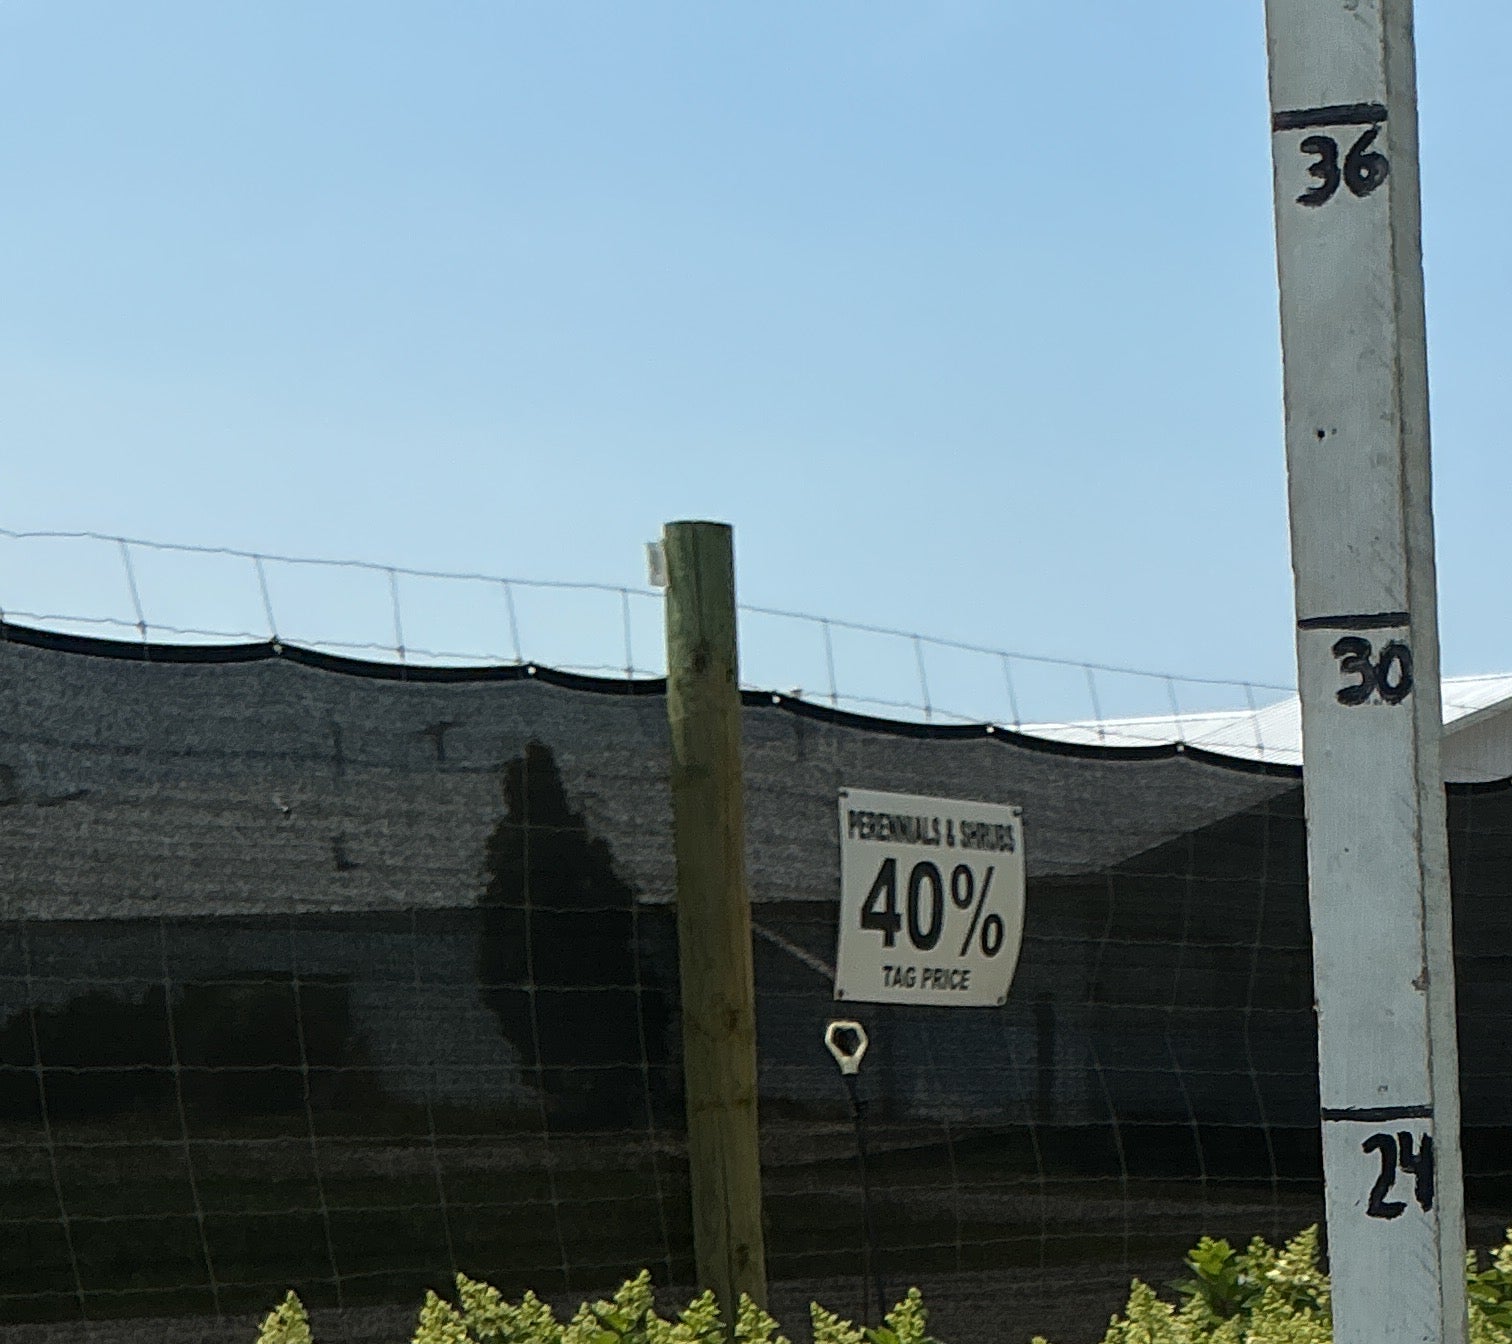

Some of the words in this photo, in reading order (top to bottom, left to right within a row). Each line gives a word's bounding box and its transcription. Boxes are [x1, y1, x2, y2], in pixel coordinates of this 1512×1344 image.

[1296, 123, 1390, 208] 36
[1331, 636, 1414, 706] 30
[861, 857, 1004, 957] 40%
[882, 965, 916, 988] TAG
[920, 967, 970, 990] PRICE
[1361, 1130, 1435, 1221] 24
